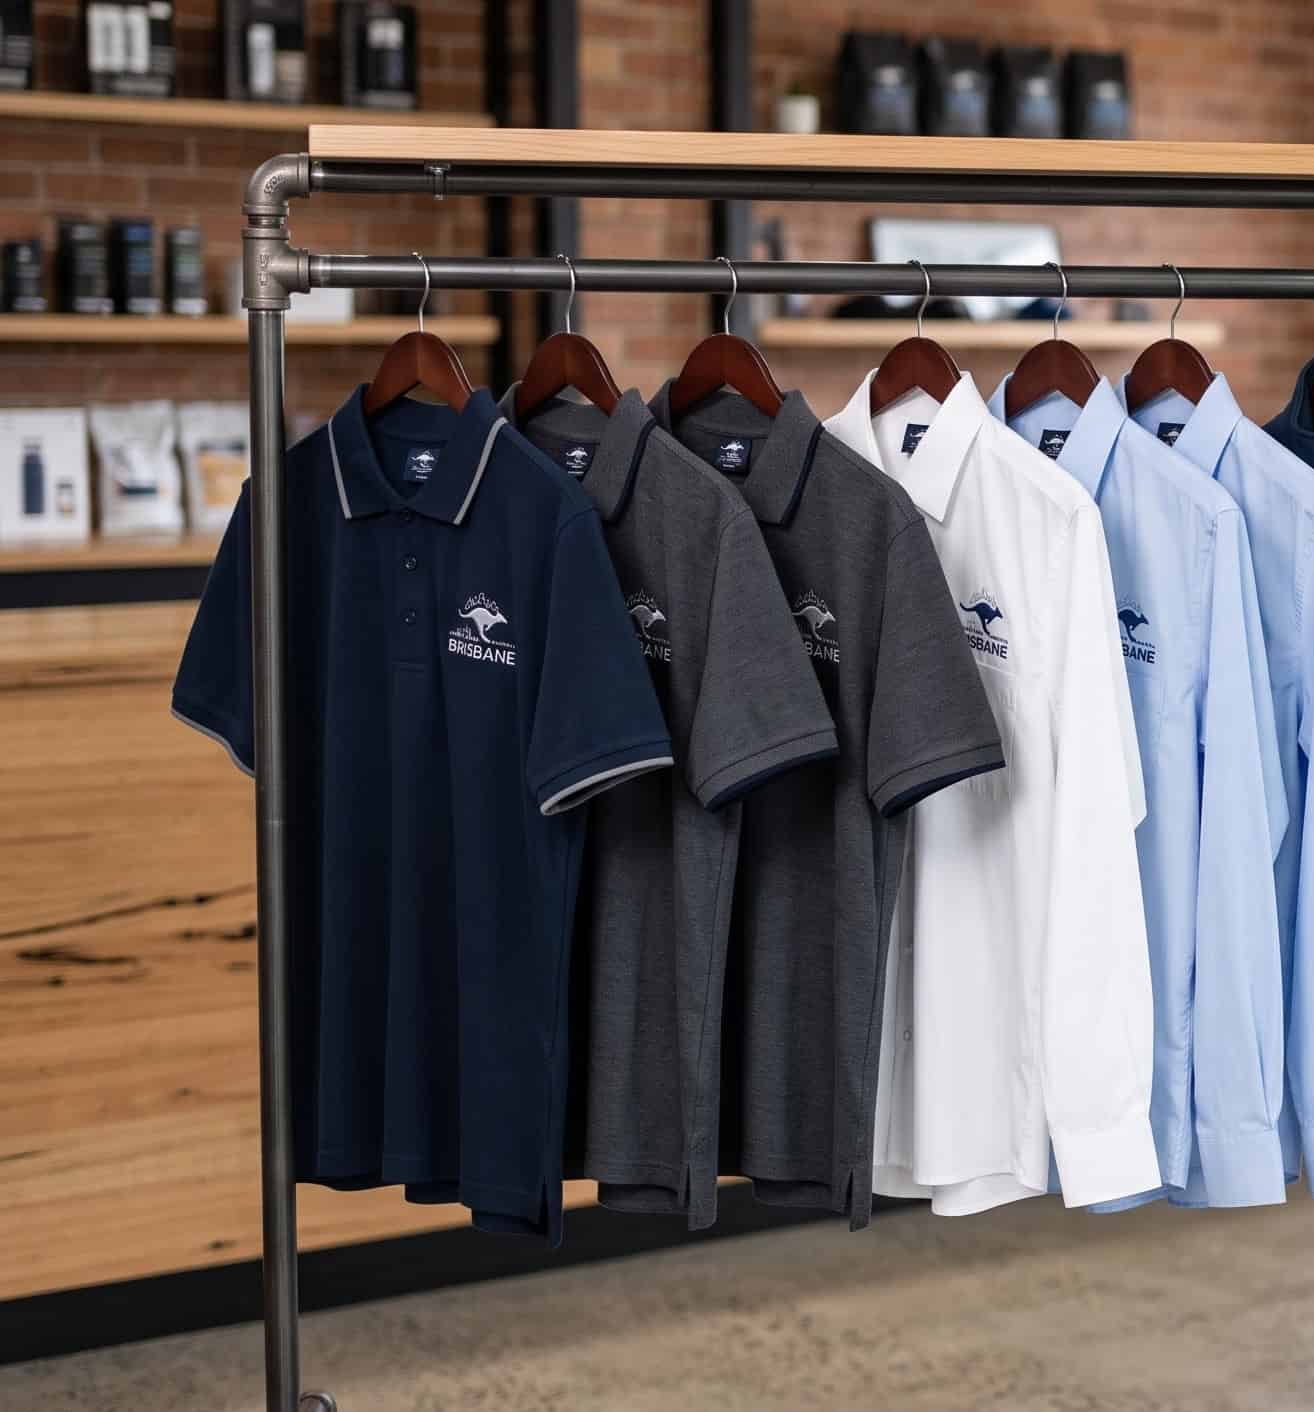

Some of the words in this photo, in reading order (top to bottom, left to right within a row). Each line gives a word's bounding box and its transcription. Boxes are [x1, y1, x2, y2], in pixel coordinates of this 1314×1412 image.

[448, 638, 516, 666] BRISBANE
[804, 641, 840, 663] BANE
[967, 634, 1008, 659] ISBANE
[1122, 643, 1155, 664] BANE
